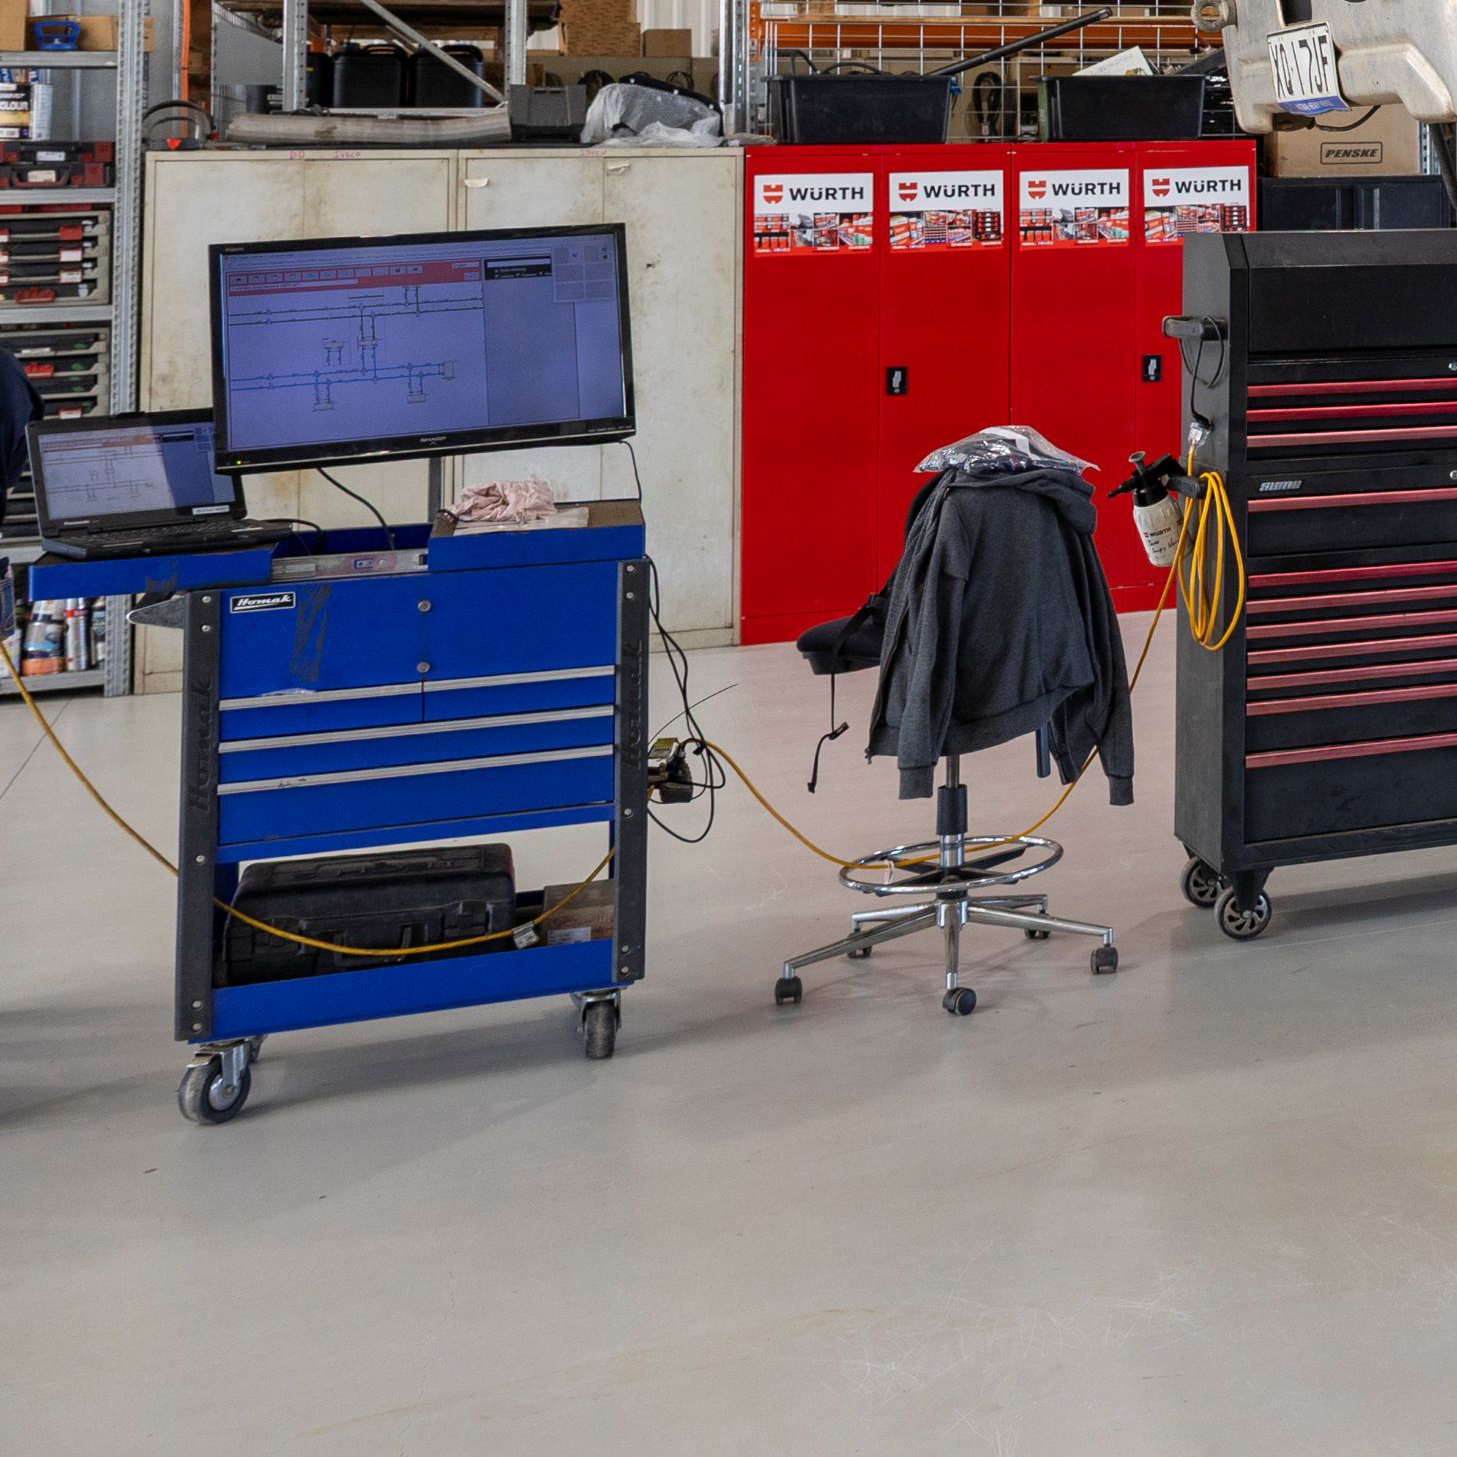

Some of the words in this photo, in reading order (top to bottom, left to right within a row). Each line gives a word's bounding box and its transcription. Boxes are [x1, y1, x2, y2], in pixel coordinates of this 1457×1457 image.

[1325, 149, 1379, 158] PENSKE
[790, 186, 864, 202] WÜRTH
[924, 184, 995, 199] WÜRTH
[1052, 182, 1120, 196] WÜRTH
[1175, 179, 1242, 194] WÜRTH
[234, 594, 293, 611] Homak
